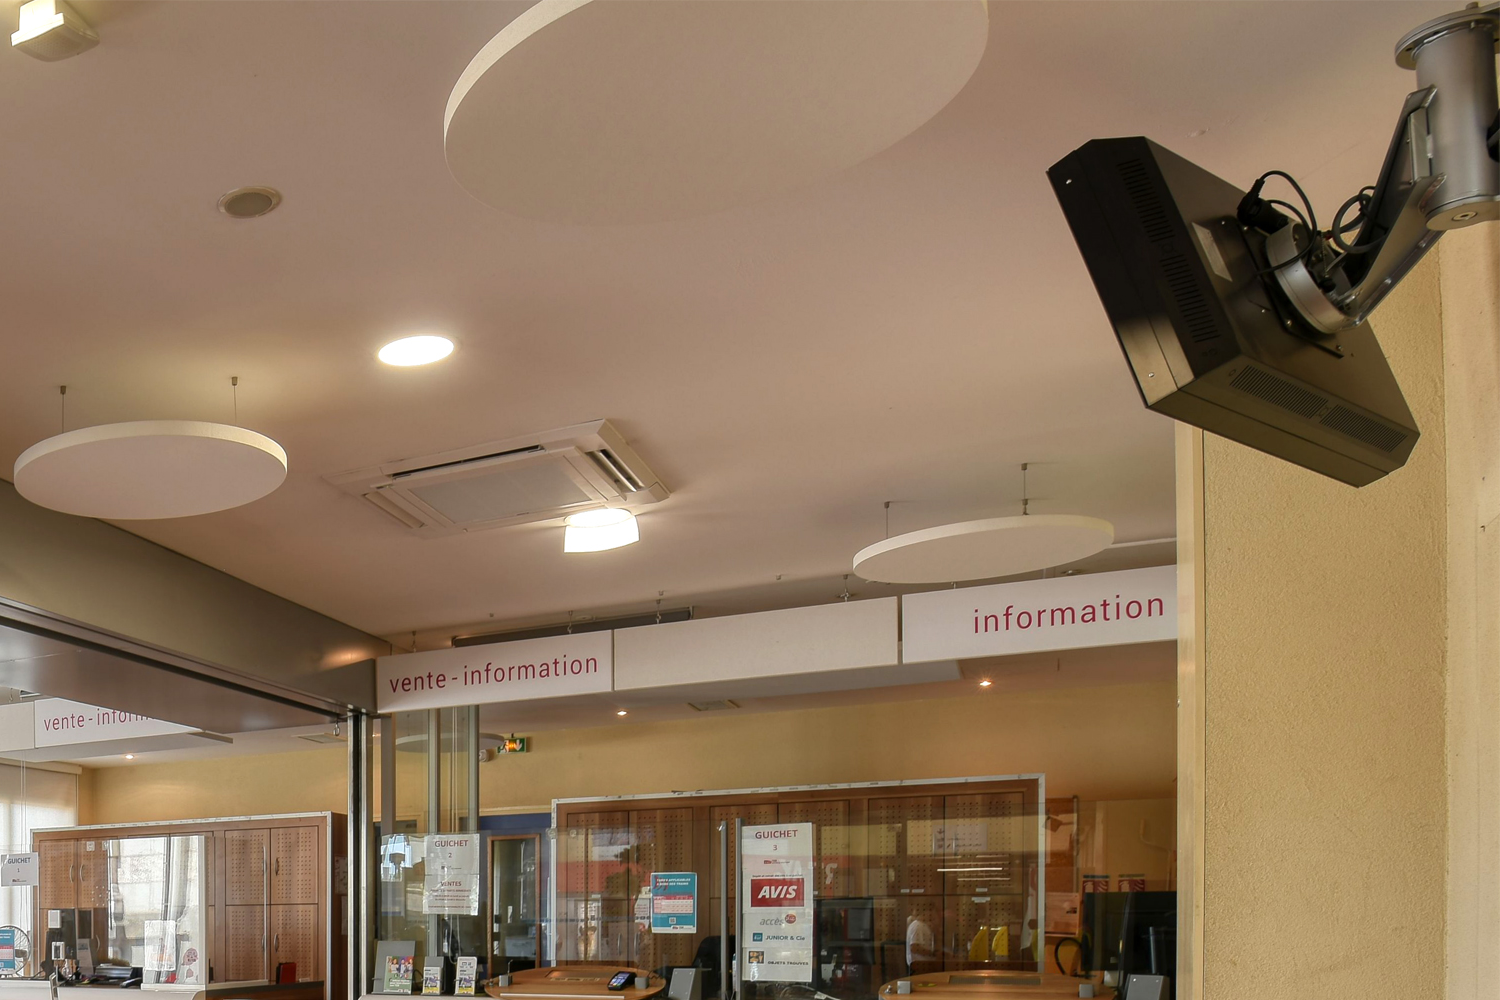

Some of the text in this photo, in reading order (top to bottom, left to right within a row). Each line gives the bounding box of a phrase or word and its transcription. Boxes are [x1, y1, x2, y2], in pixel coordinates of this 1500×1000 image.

[974, 594, 1164, 633] information
[390, 671, 446, 693] vente
[463, 654, 598, 686] information
[43, 713, 85, 731] vente
[755, 829, 798, 839] GUICHET
[757, 885, 798, 899] AVIS
[759, 917, 784, 926] accès
